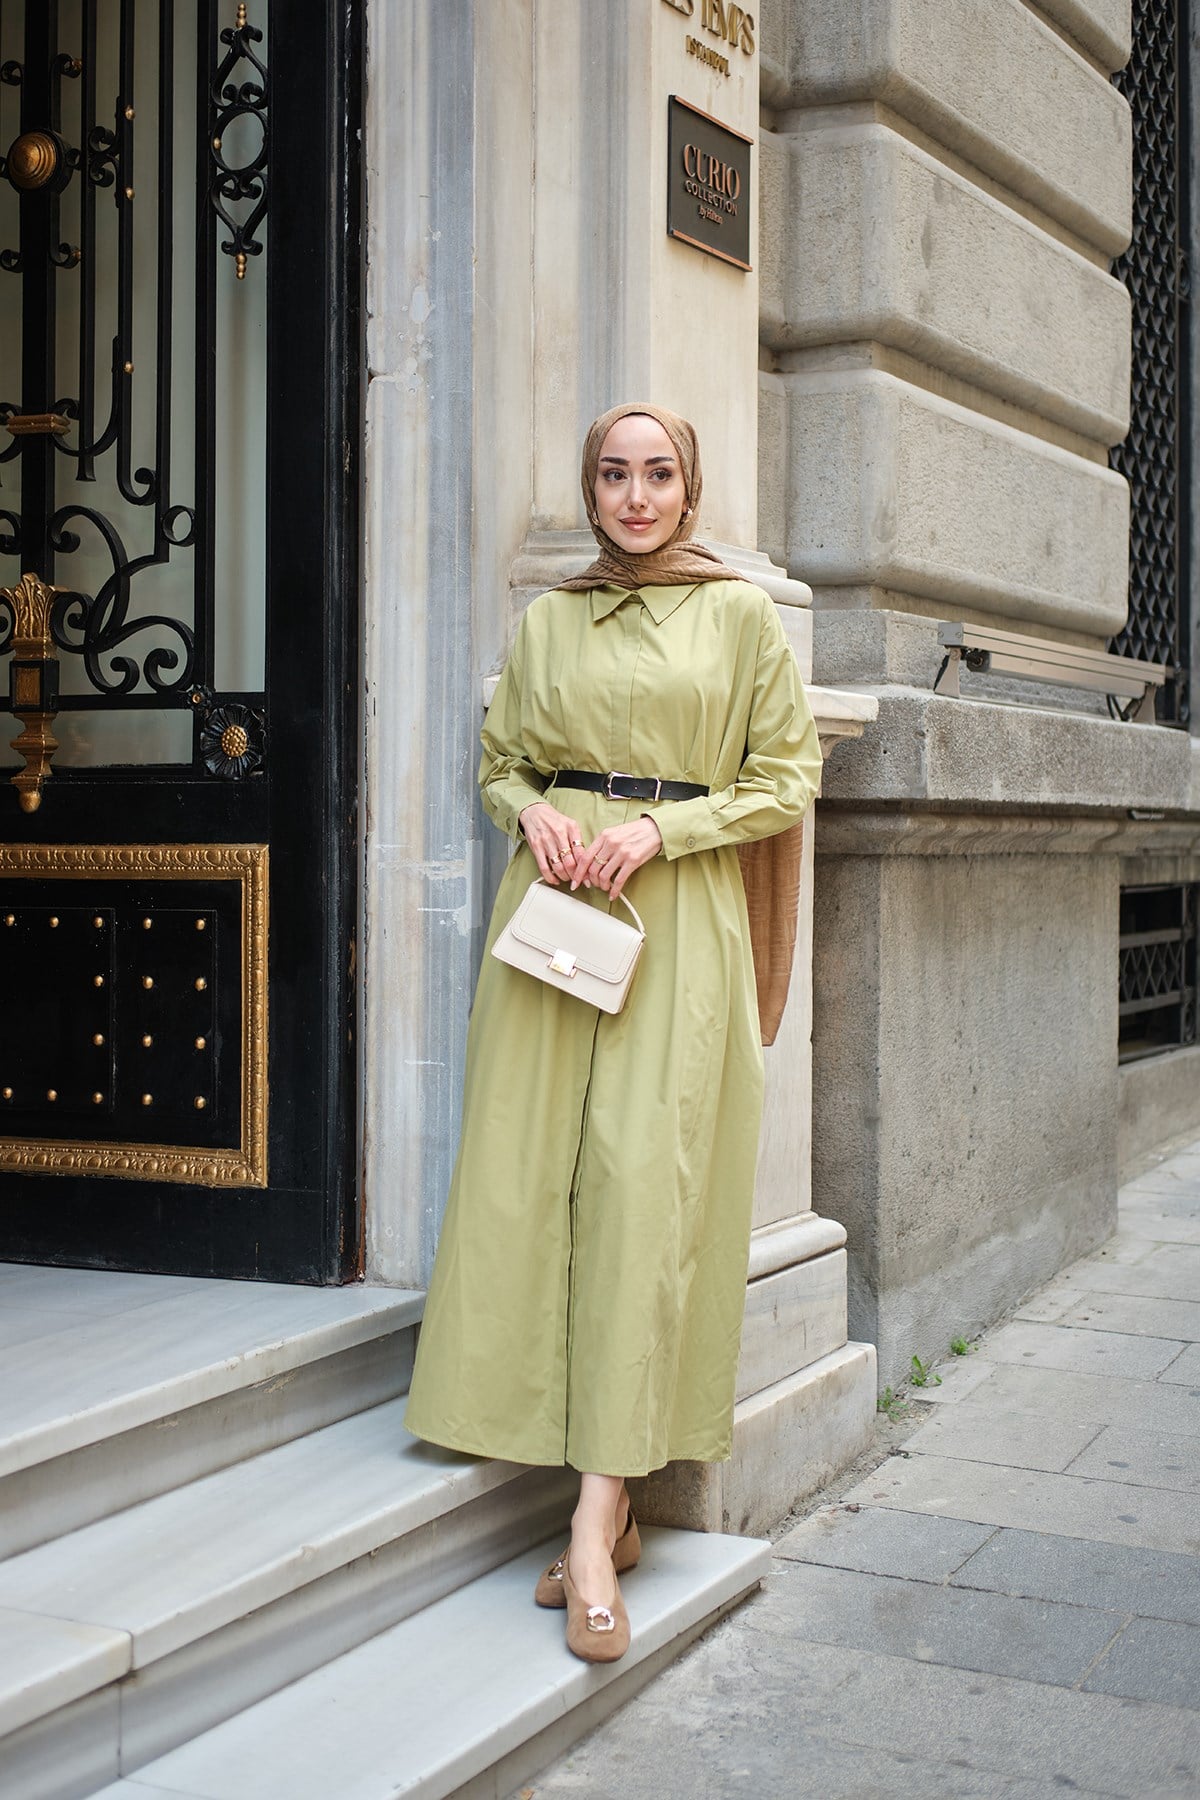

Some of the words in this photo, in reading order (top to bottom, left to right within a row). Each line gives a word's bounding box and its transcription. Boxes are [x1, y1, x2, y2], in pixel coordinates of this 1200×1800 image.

[684, 144, 741, 200] CURIO
[685, 179, 738, 217] COLLECTION
[699, 205, 707, 220] by
[706, 209, 723, 225] Hilton
